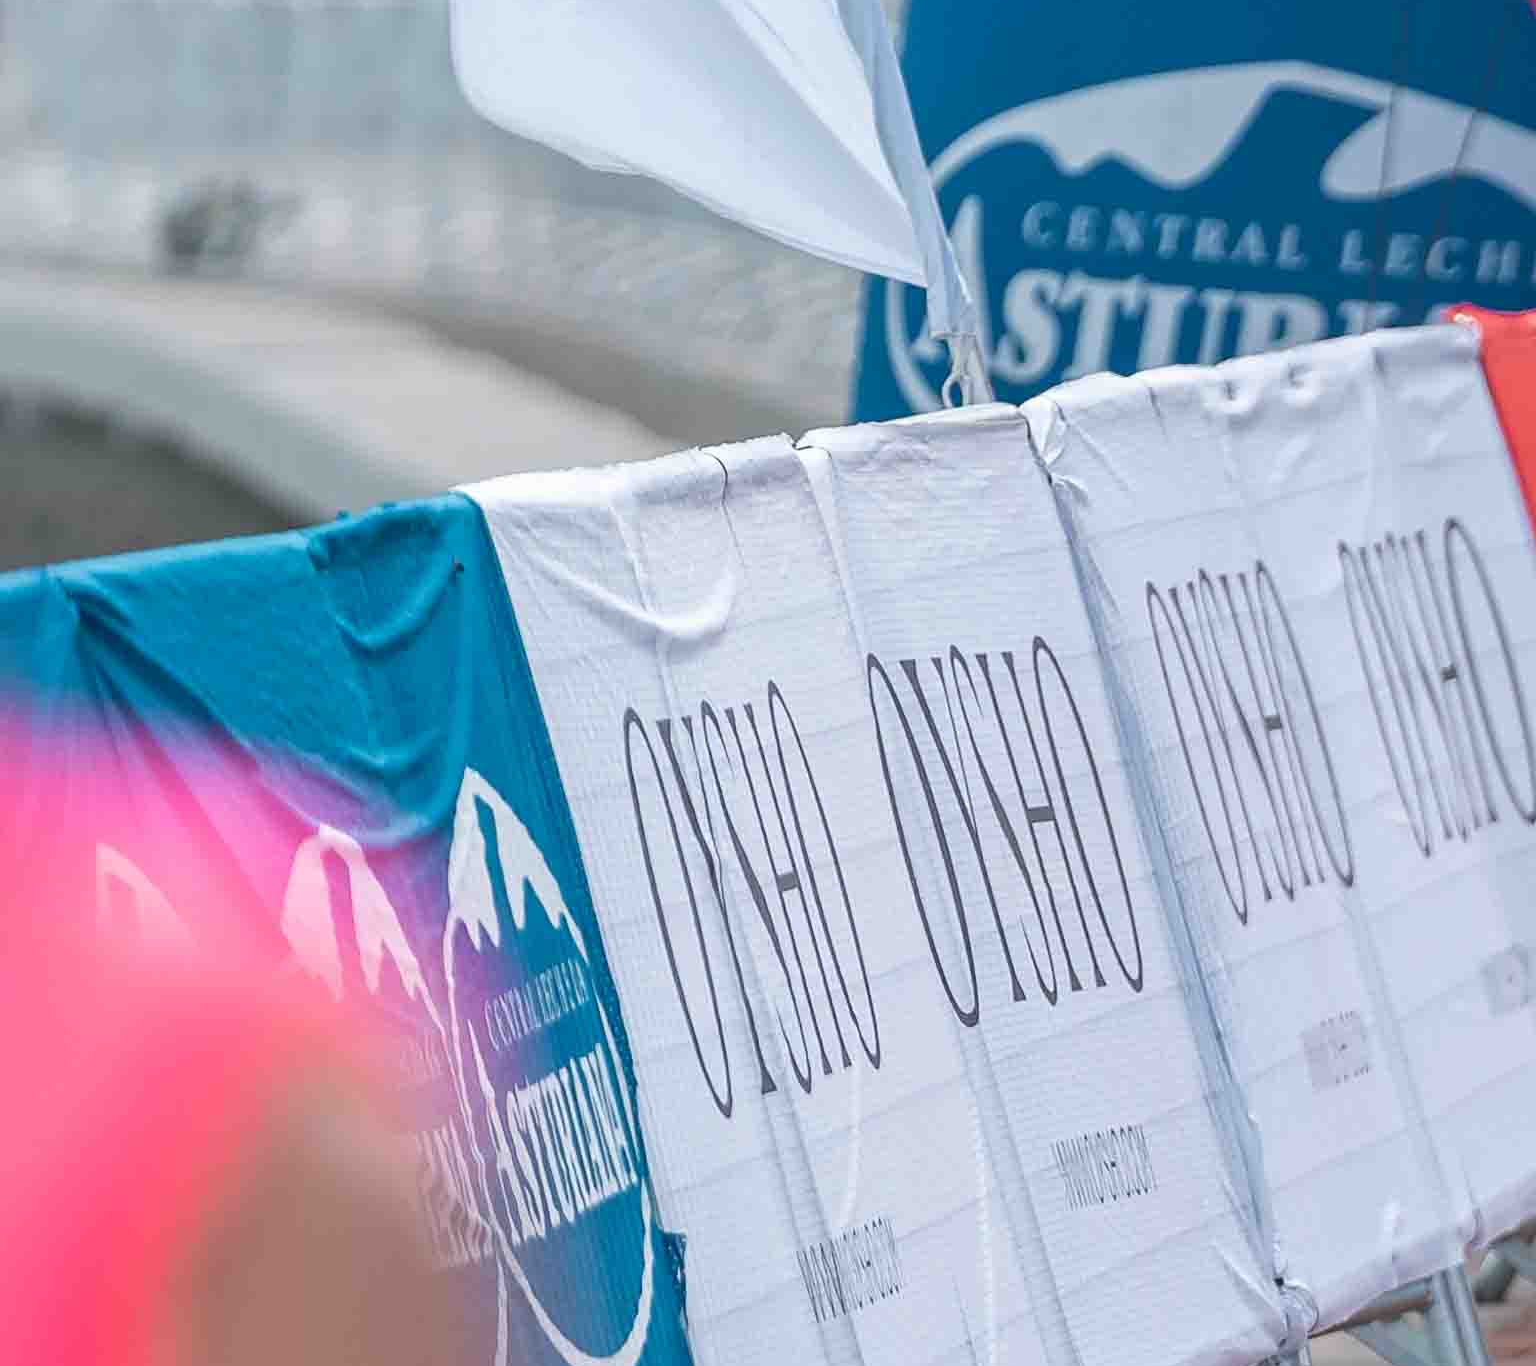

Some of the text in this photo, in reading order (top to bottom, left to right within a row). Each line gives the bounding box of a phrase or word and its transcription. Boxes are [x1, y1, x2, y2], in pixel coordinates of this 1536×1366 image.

[1022, 199, 1307, 273] CENTRAL
[623, 680, 882, 1119] OYSHO
[867, 635, 1145, 1027] OYSHO
[1145, 559, 1356, 926] OYSHO
[468, 1019, 639, 1246] ASTURIANA
